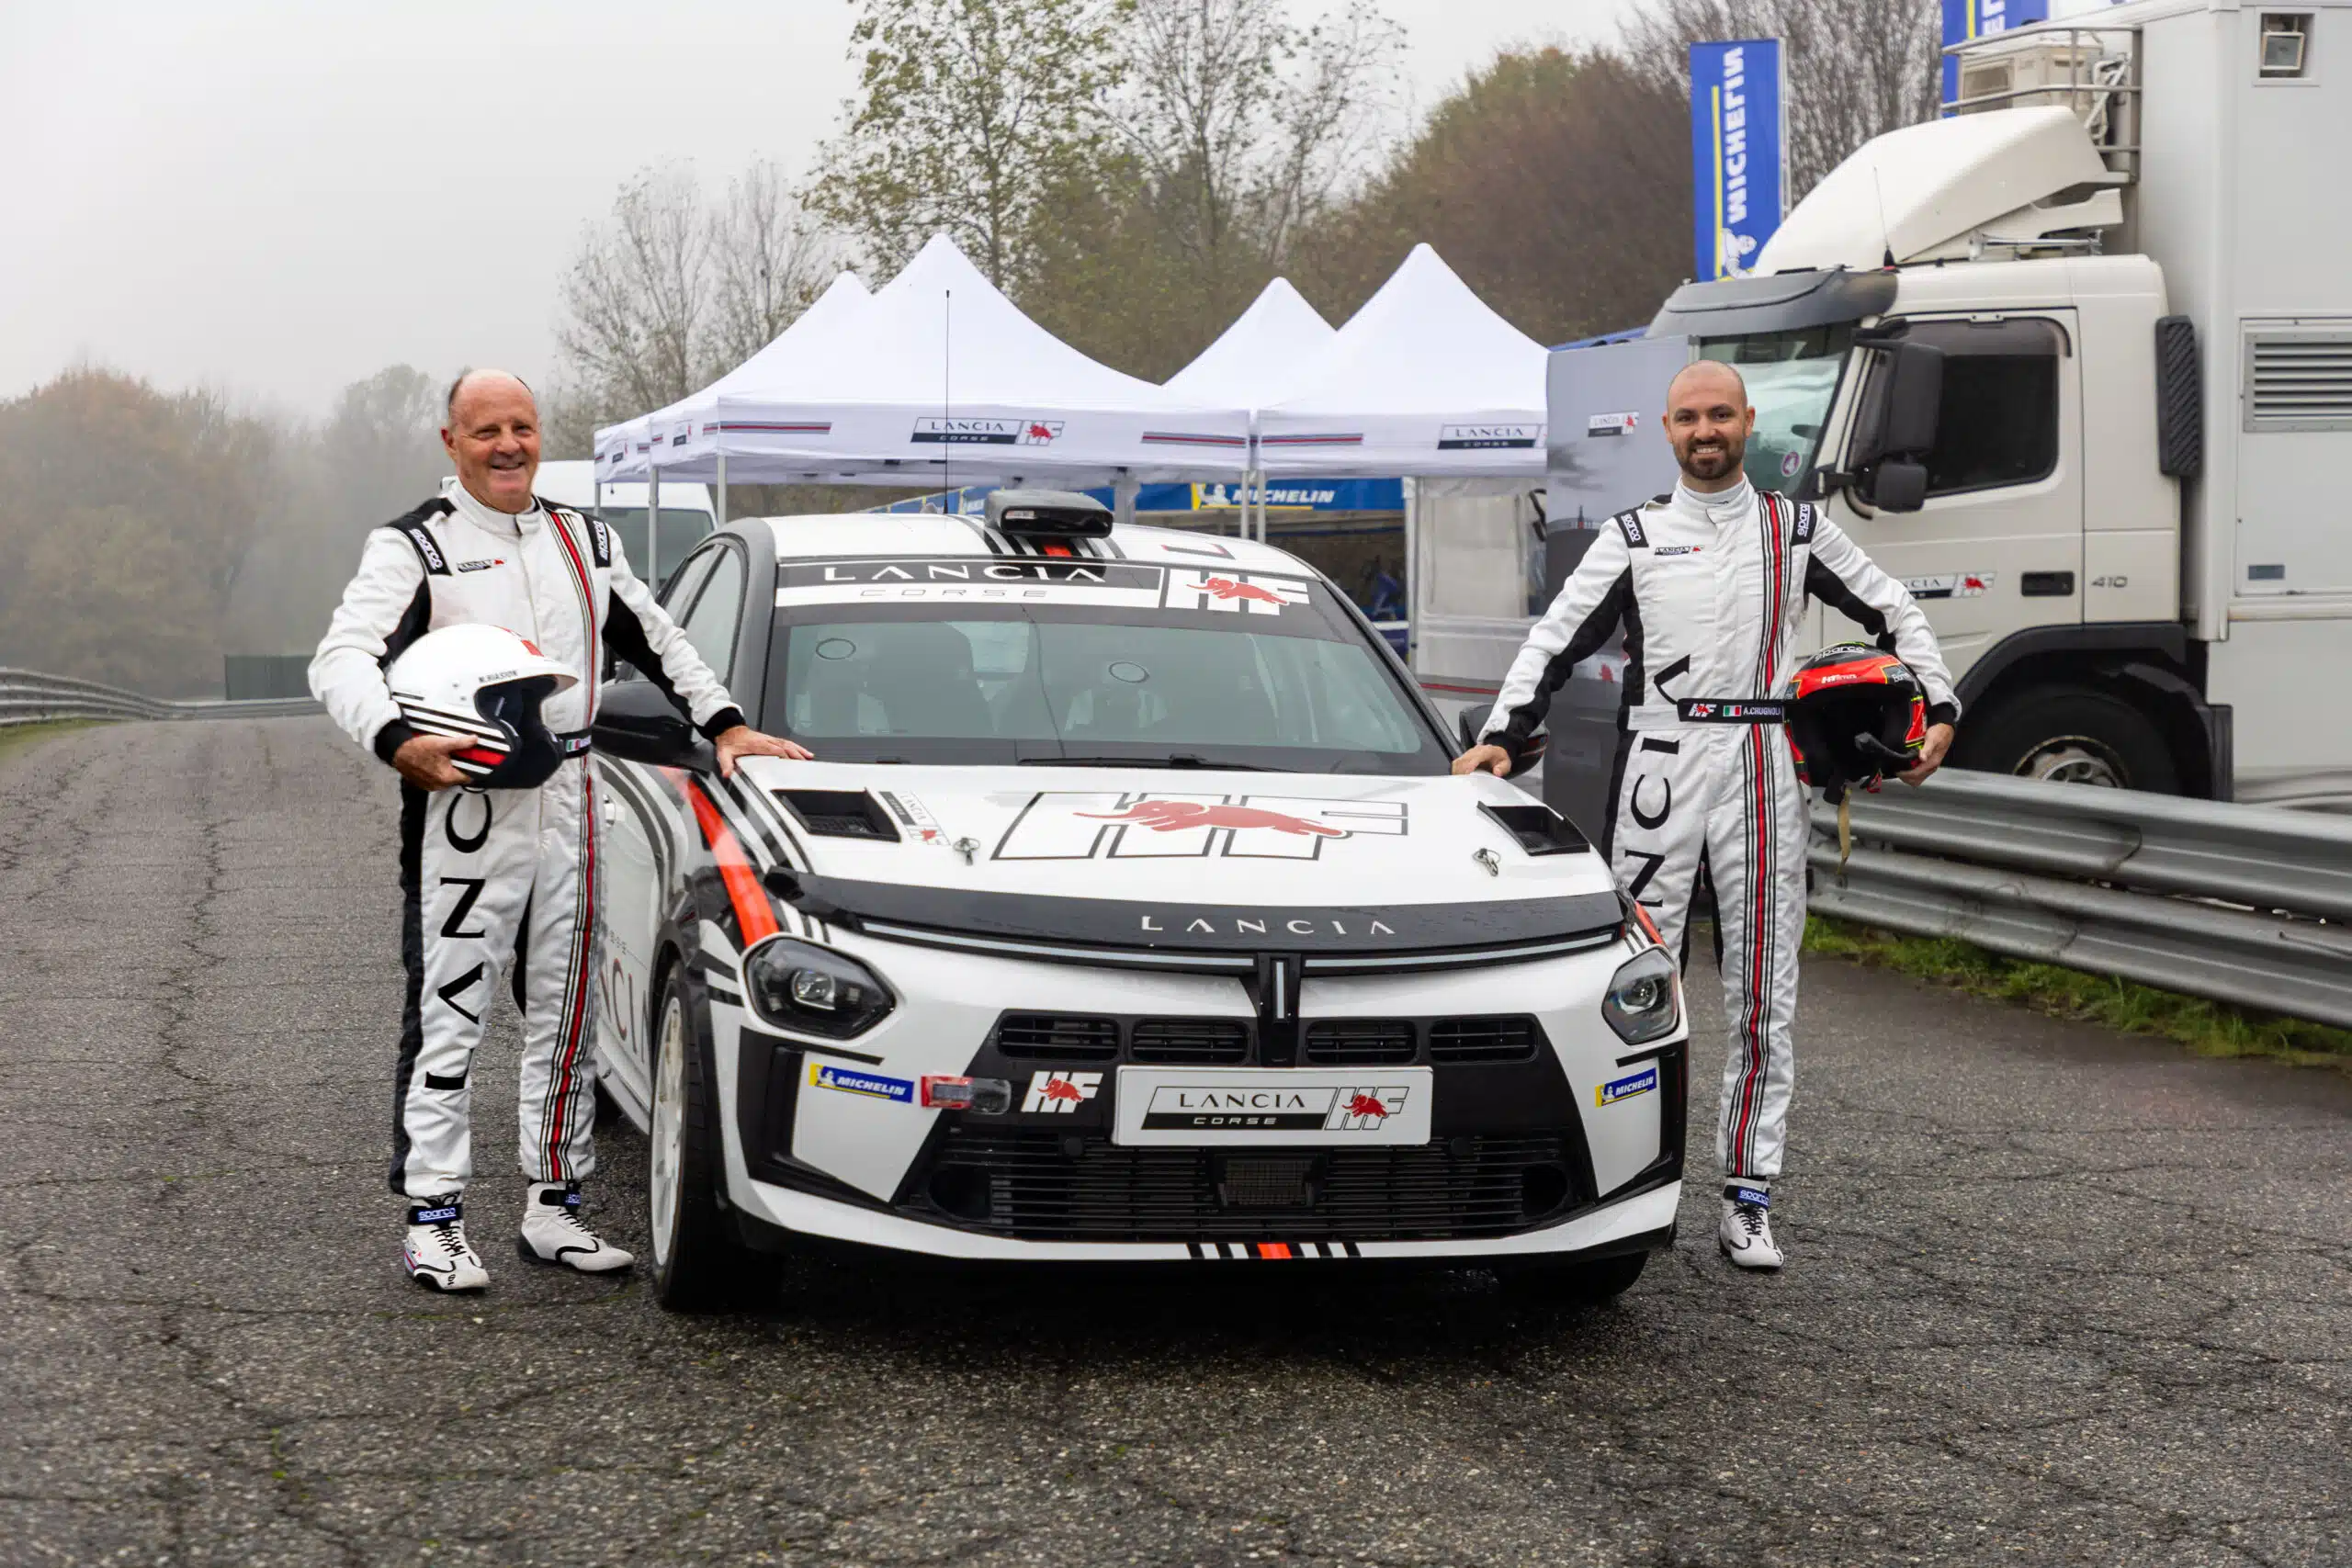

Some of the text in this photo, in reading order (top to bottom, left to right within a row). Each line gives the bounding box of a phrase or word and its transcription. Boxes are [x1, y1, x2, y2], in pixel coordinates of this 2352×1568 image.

[931, 421, 1004, 432] LANCIA
[1455, 426, 1524, 437] LANCIA
[824, 564, 1107, 583] LANCIA
[2091, 576, 2129, 589] 410
[860, 589, 1048, 597] CORSE
[1815, 645, 1865, 662] sparco
[1141, 915, 1396, 935] LANCIA
[836, 1076, 907, 1096] MICHELIN
[1615, 1076, 1655, 1096] MICHELIN
[1179, 1092, 1306, 1109] LANCIA
[1193, 1116, 1278, 1125] CORSE
[418, 1207, 457, 1222] sparco
